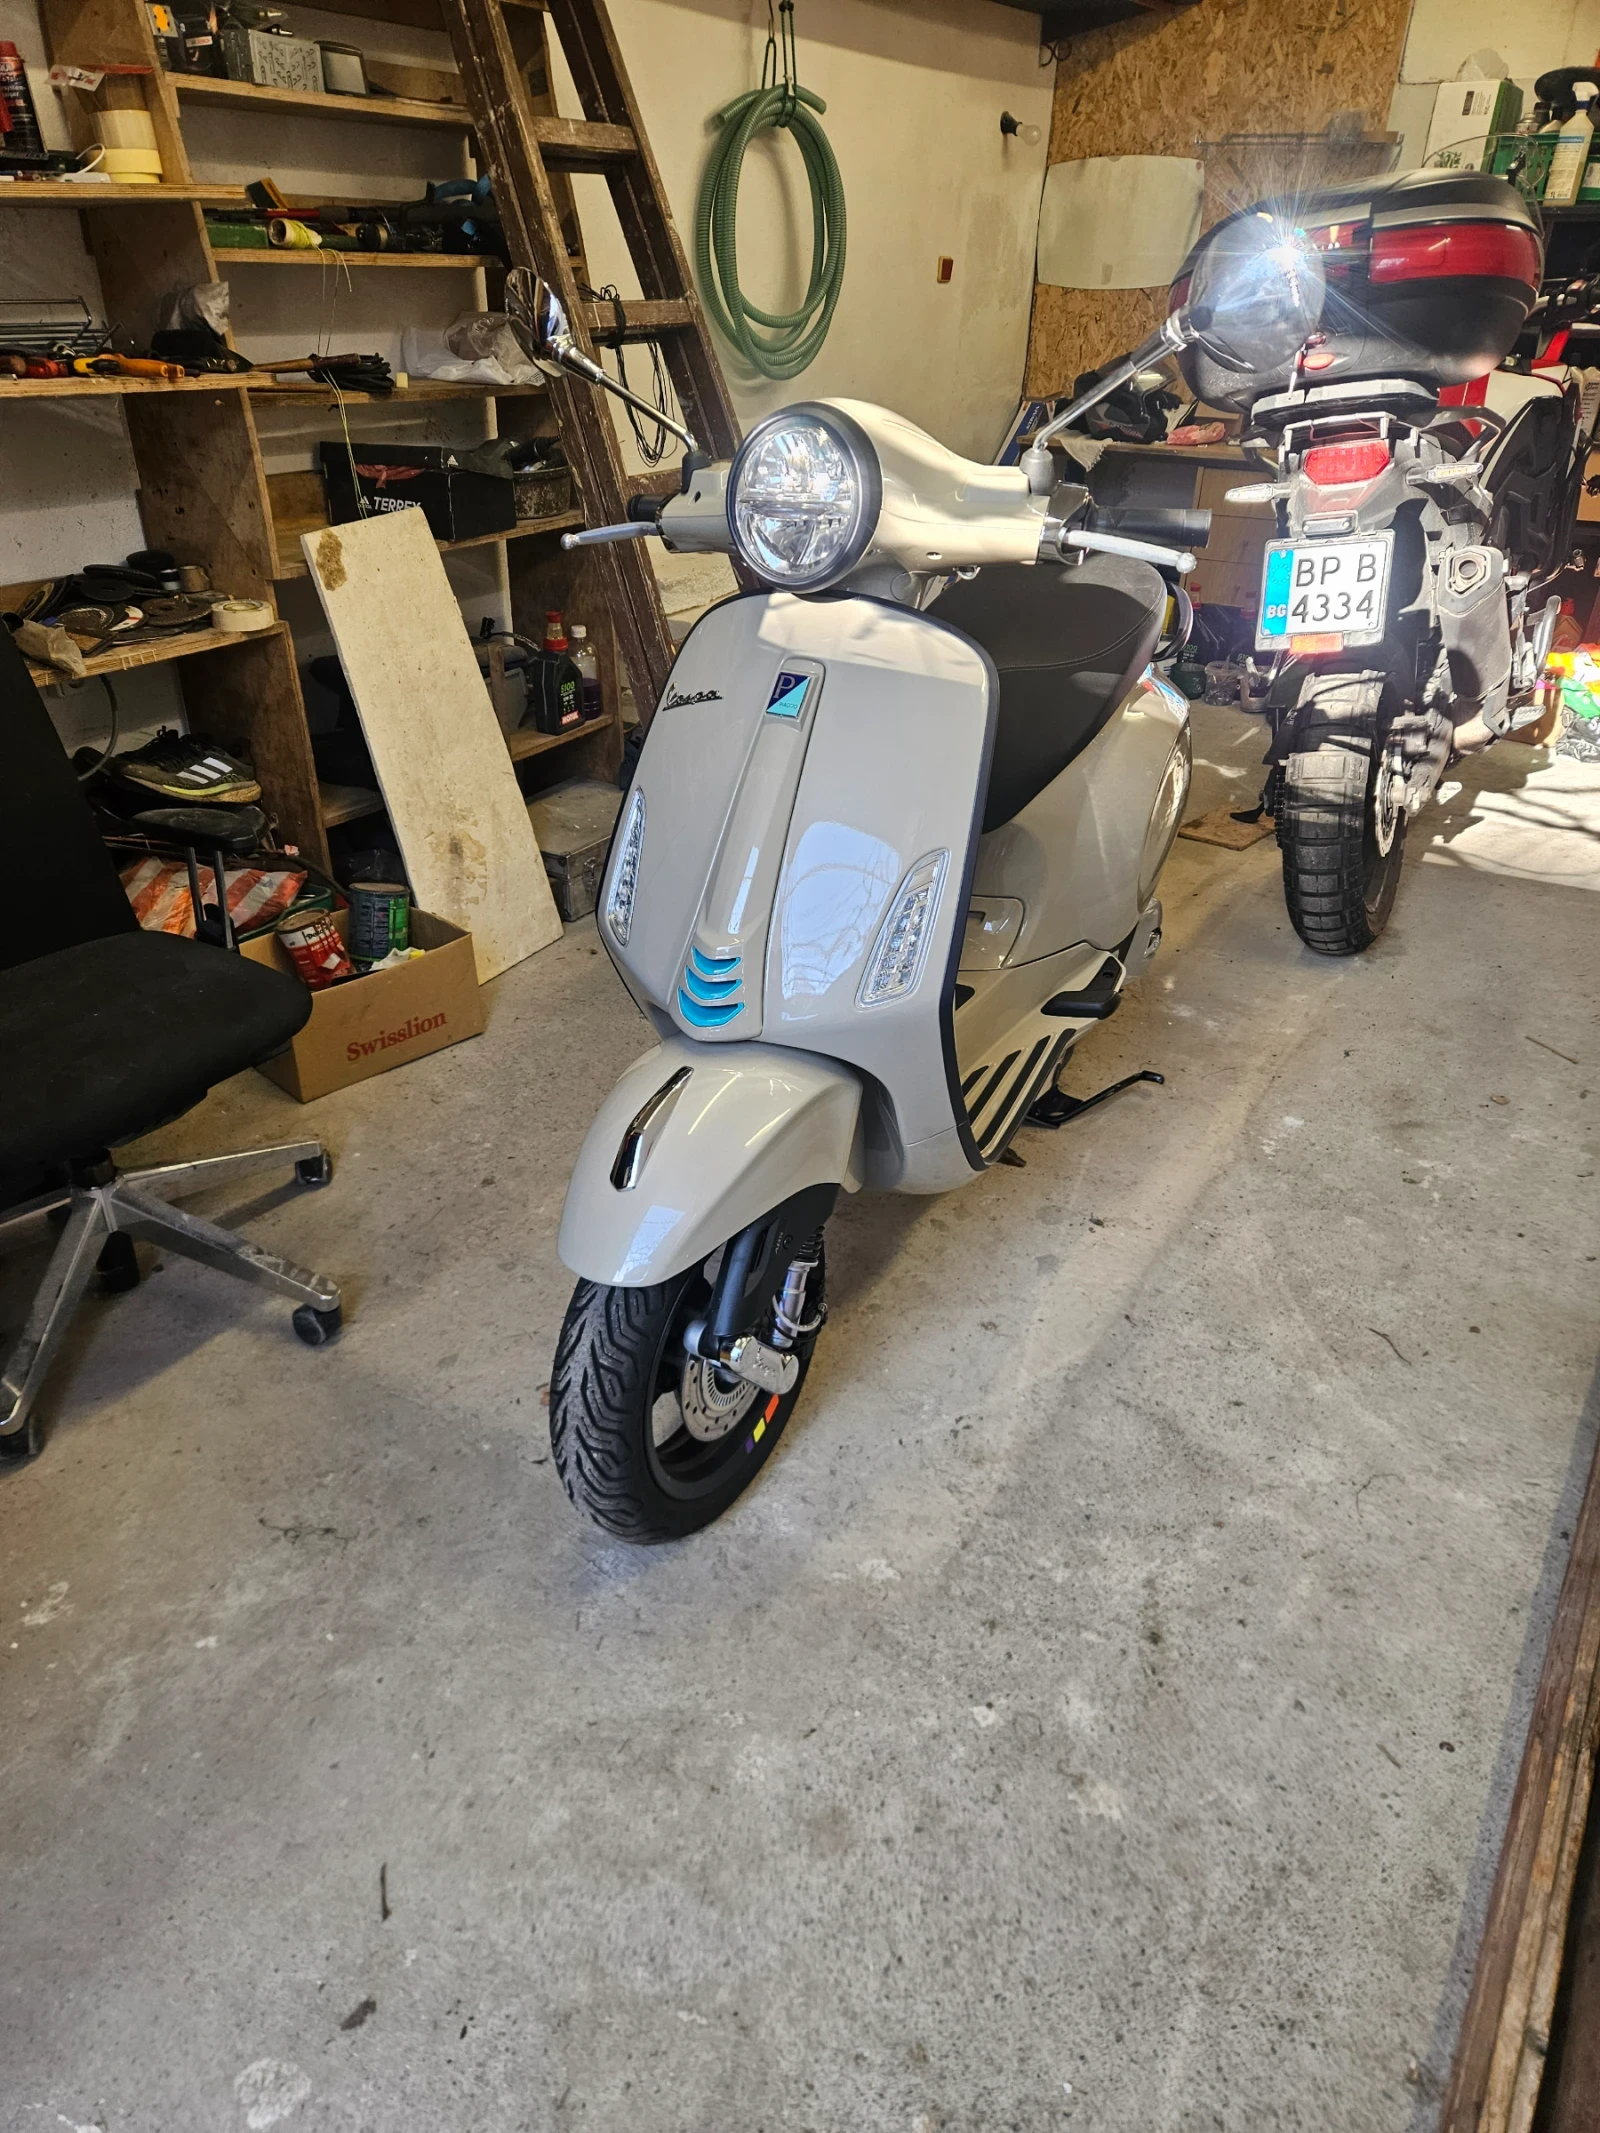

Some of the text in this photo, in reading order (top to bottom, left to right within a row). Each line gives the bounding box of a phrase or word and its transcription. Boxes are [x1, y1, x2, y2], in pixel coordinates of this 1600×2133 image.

[1296, 553, 1377, 588] BP B
[1266, 604, 1287, 619] BG
[1291, 589, 1374, 624] 4334
[662, 682, 723, 712] Vespa
[346, 1012, 449, 1062] Swisslion
